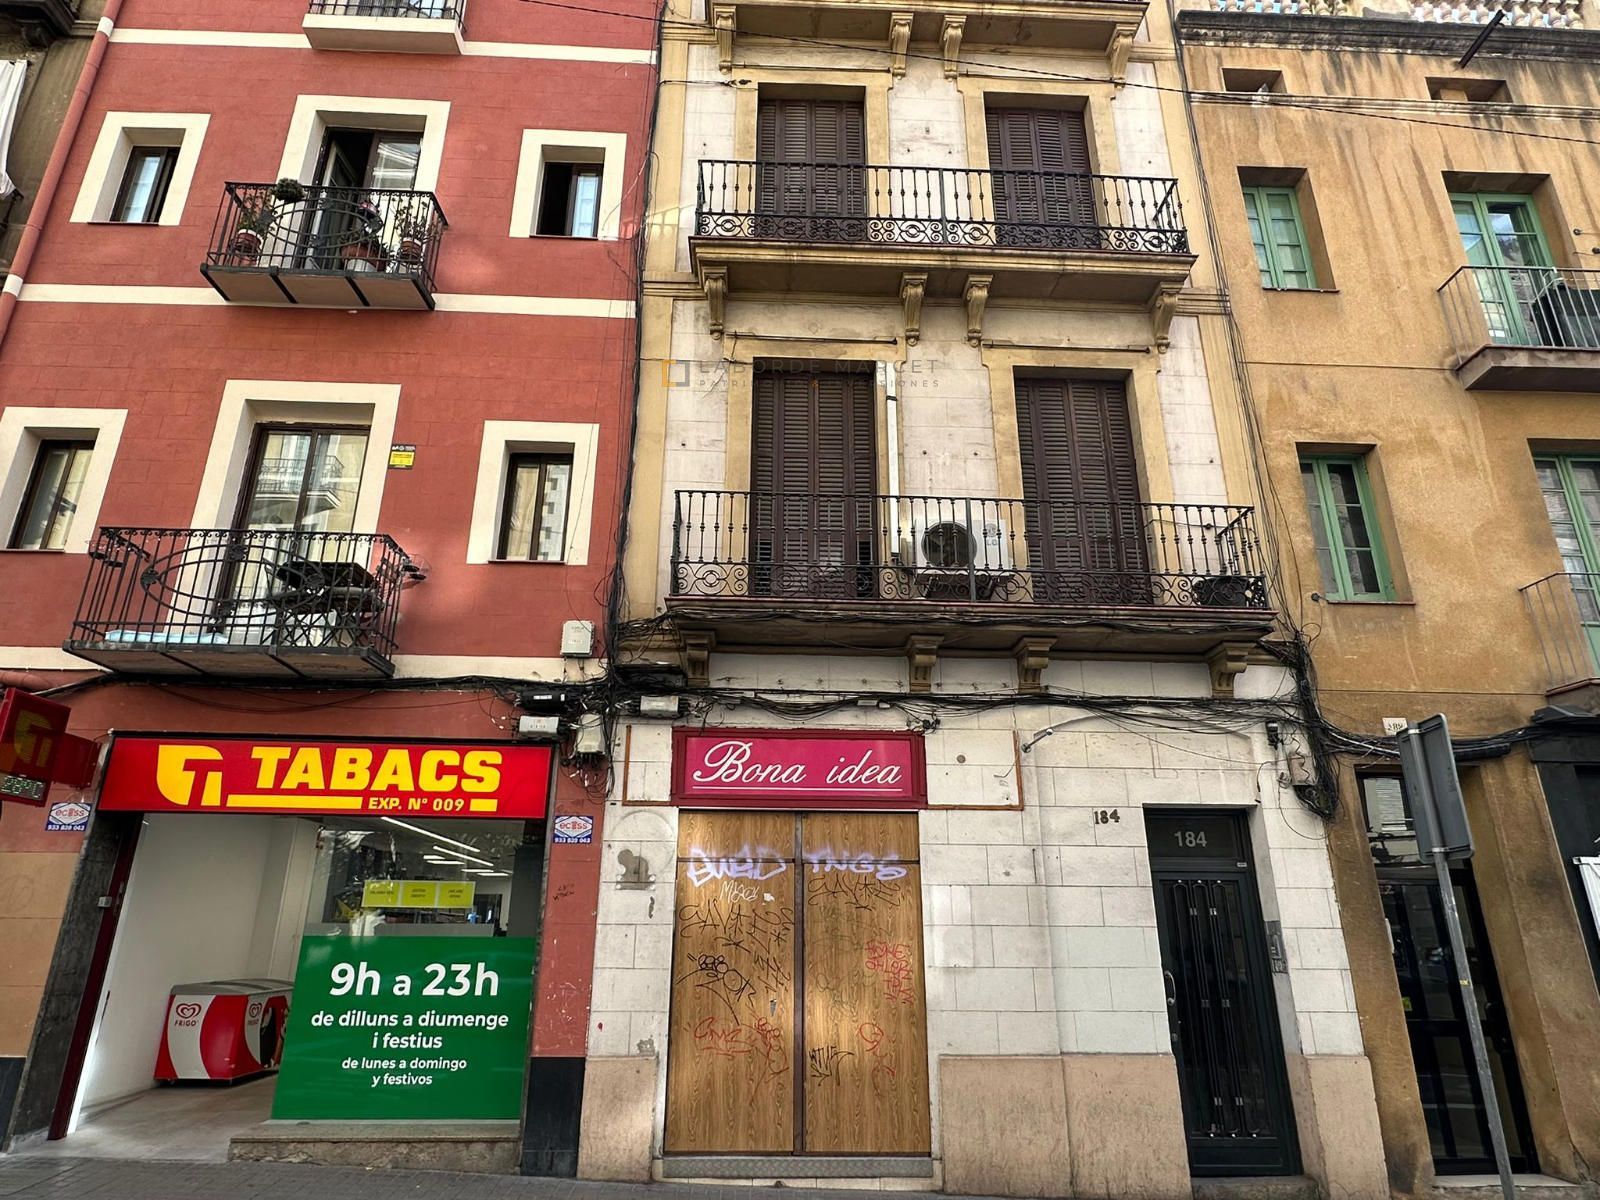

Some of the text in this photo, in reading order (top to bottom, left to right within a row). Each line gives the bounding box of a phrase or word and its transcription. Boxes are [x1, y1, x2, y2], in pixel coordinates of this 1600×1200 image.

[251, 746, 503, 792] TABACS
[693, 741, 902, 784] Bona idea
[368, 797, 402, 810] EXP.
[433, 798, 464, 812] 009
[1094, 809, 1121, 824] 184
[1174, 831, 1208, 847] 184
[329, 961, 499, 996] 9h a 23h
[174, 1019, 197, 1027] FRIGO
[311, 1010, 509, 1030] de dilluns a diumenge
[372, 1031, 443, 1049] i festius
[341, 1056, 467, 1071] de lunes a domingo
[371, 1073, 433, 1088] y festivos
